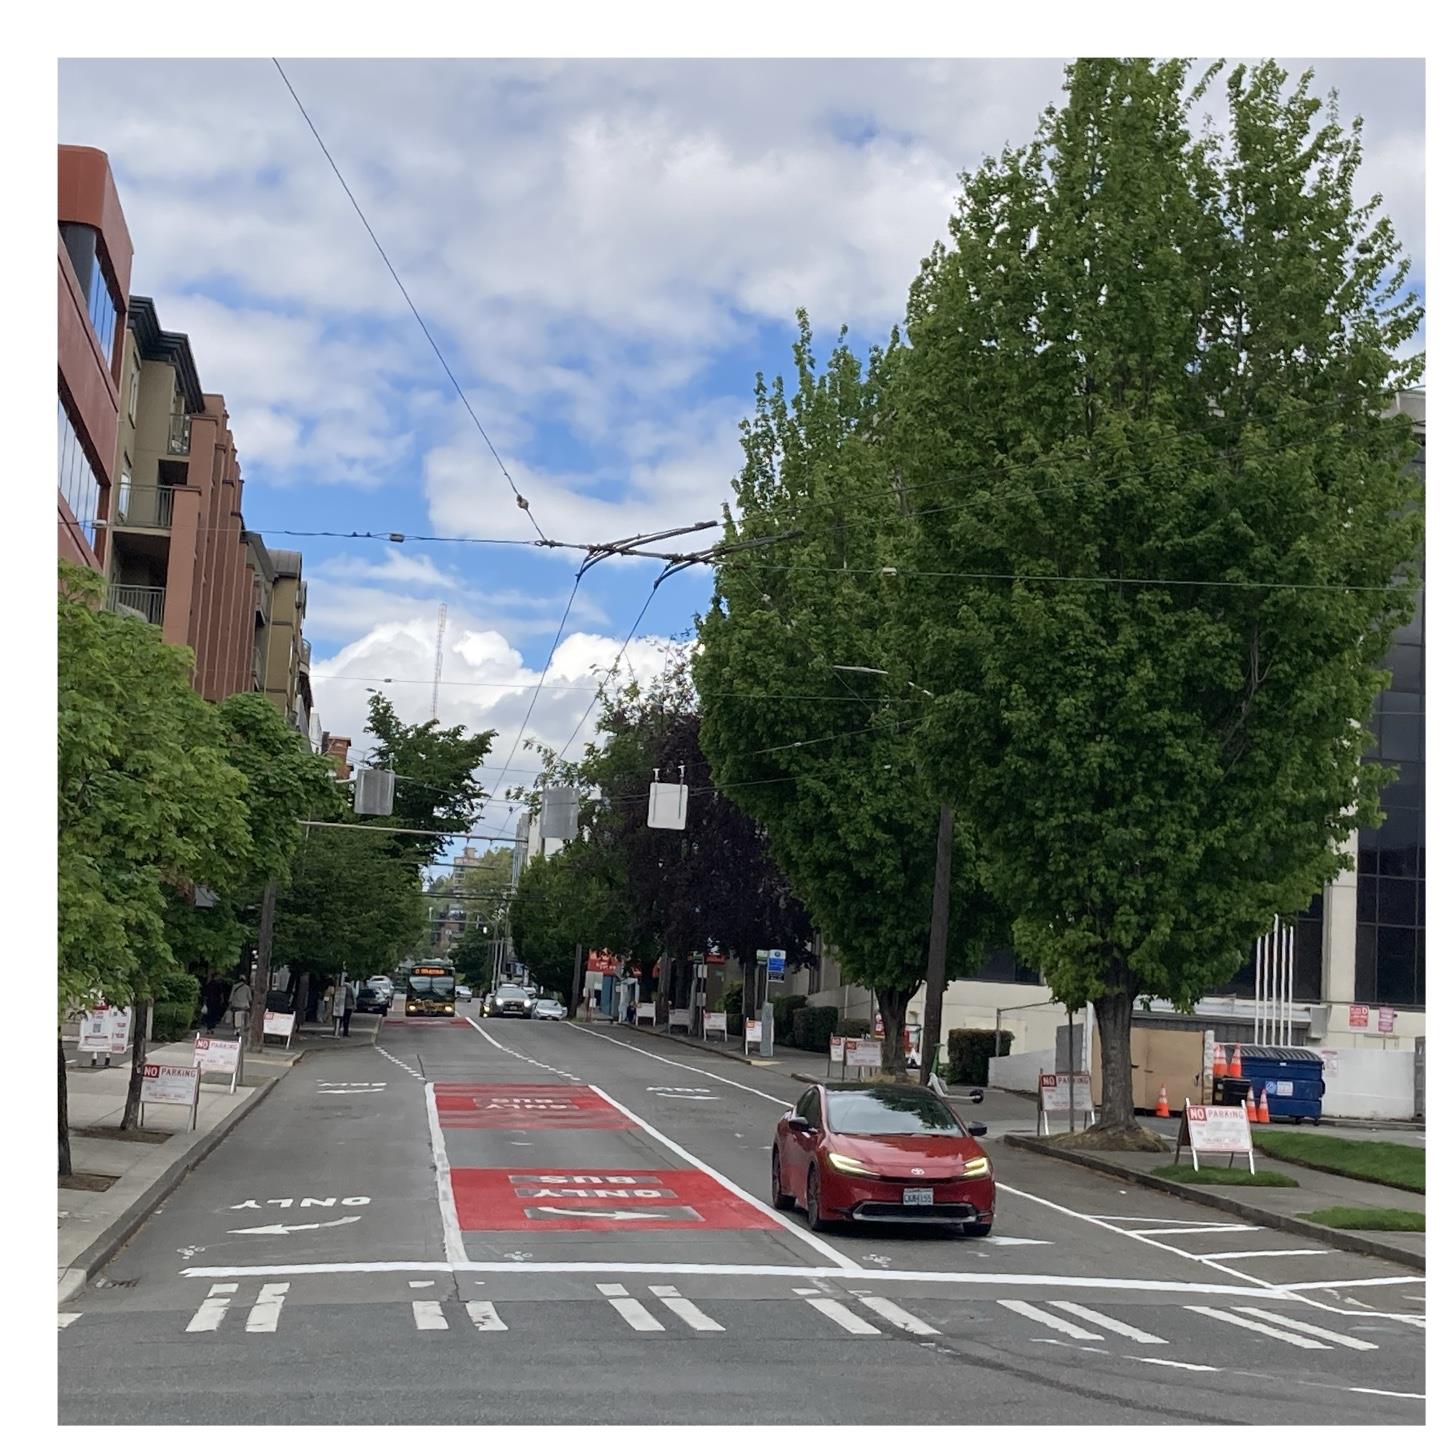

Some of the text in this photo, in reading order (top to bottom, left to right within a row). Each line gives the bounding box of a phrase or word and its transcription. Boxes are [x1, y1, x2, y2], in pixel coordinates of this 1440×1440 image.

[144, 1066, 195, 1077] NO PARKING
[1043, 1076, 1055, 1086] NO
[1190, 1107, 1244, 1119] NO PARKING
[540, 1175, 637, 1184] BUS
[533, 1188, 662, 1197] ONLY
[230, 1196, 371, 1209] ONLY
